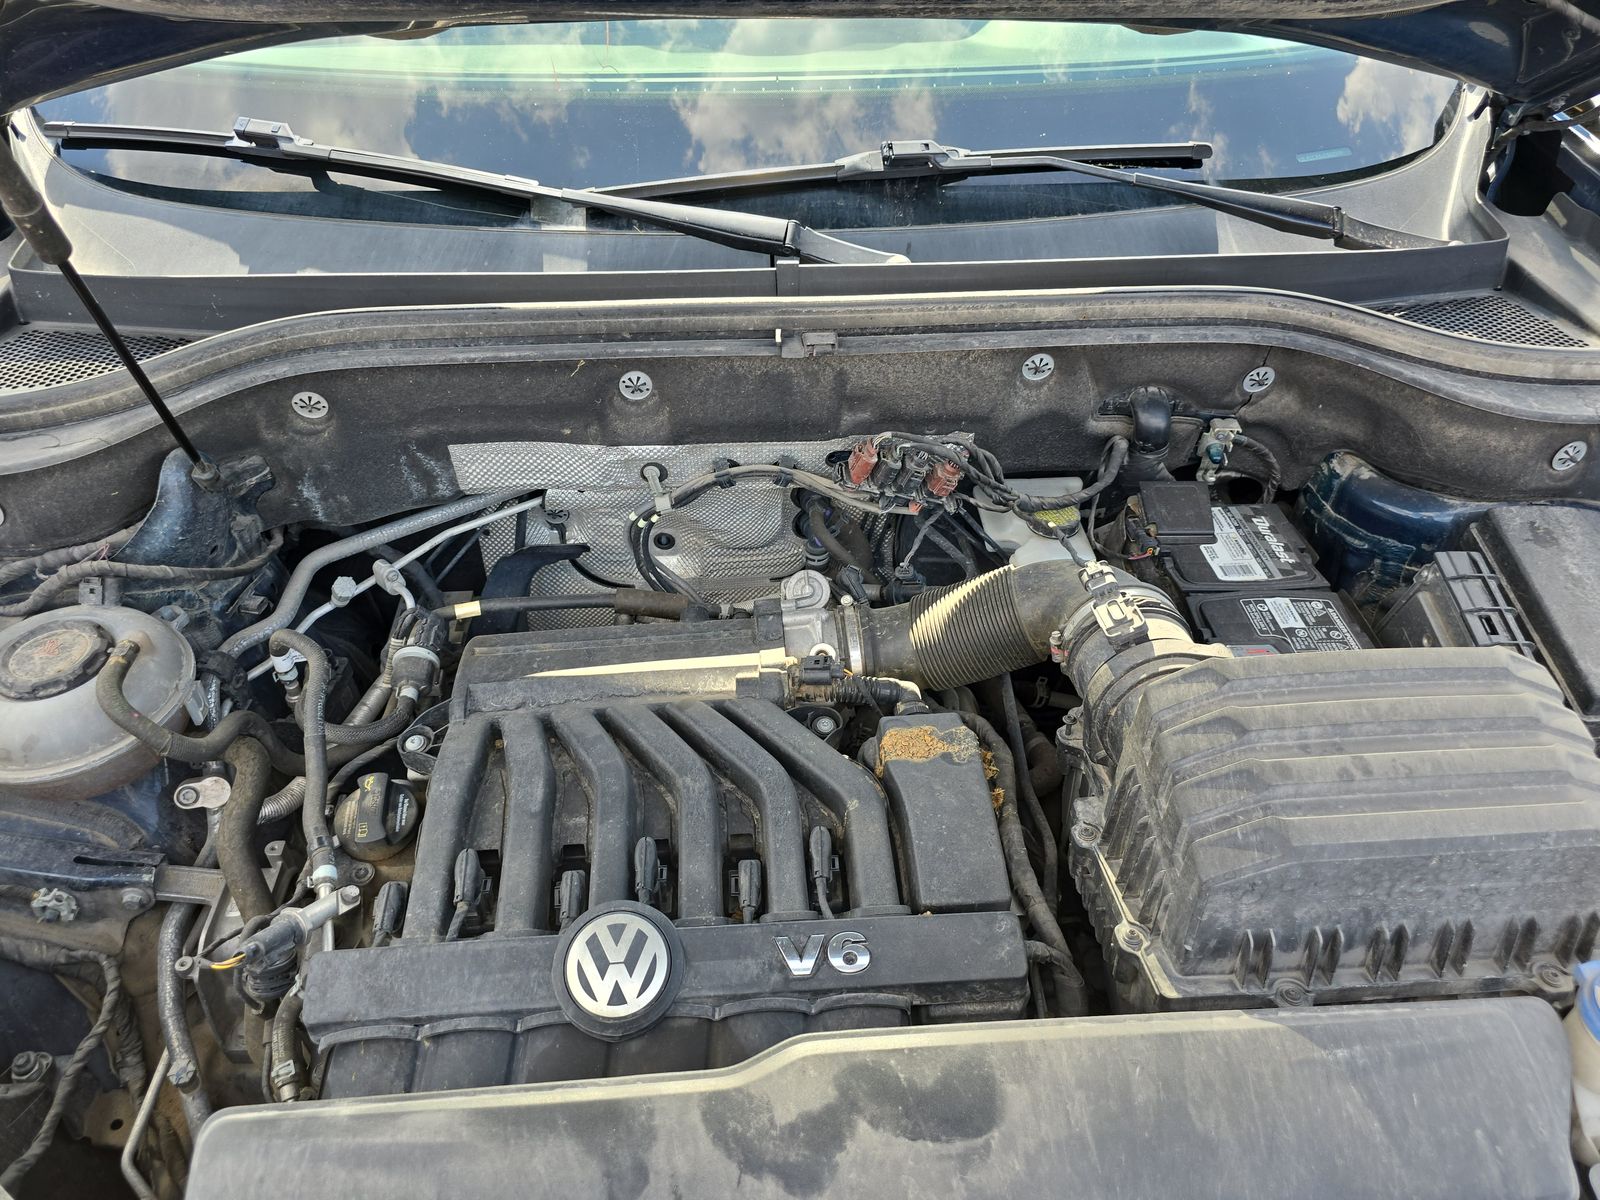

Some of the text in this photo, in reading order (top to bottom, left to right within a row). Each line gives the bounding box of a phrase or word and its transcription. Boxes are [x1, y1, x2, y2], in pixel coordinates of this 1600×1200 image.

[1252, 515, 1296, 563] Duralast
[569, 915, 665, 1013] VW
[773, 930, 872, 976] V6
